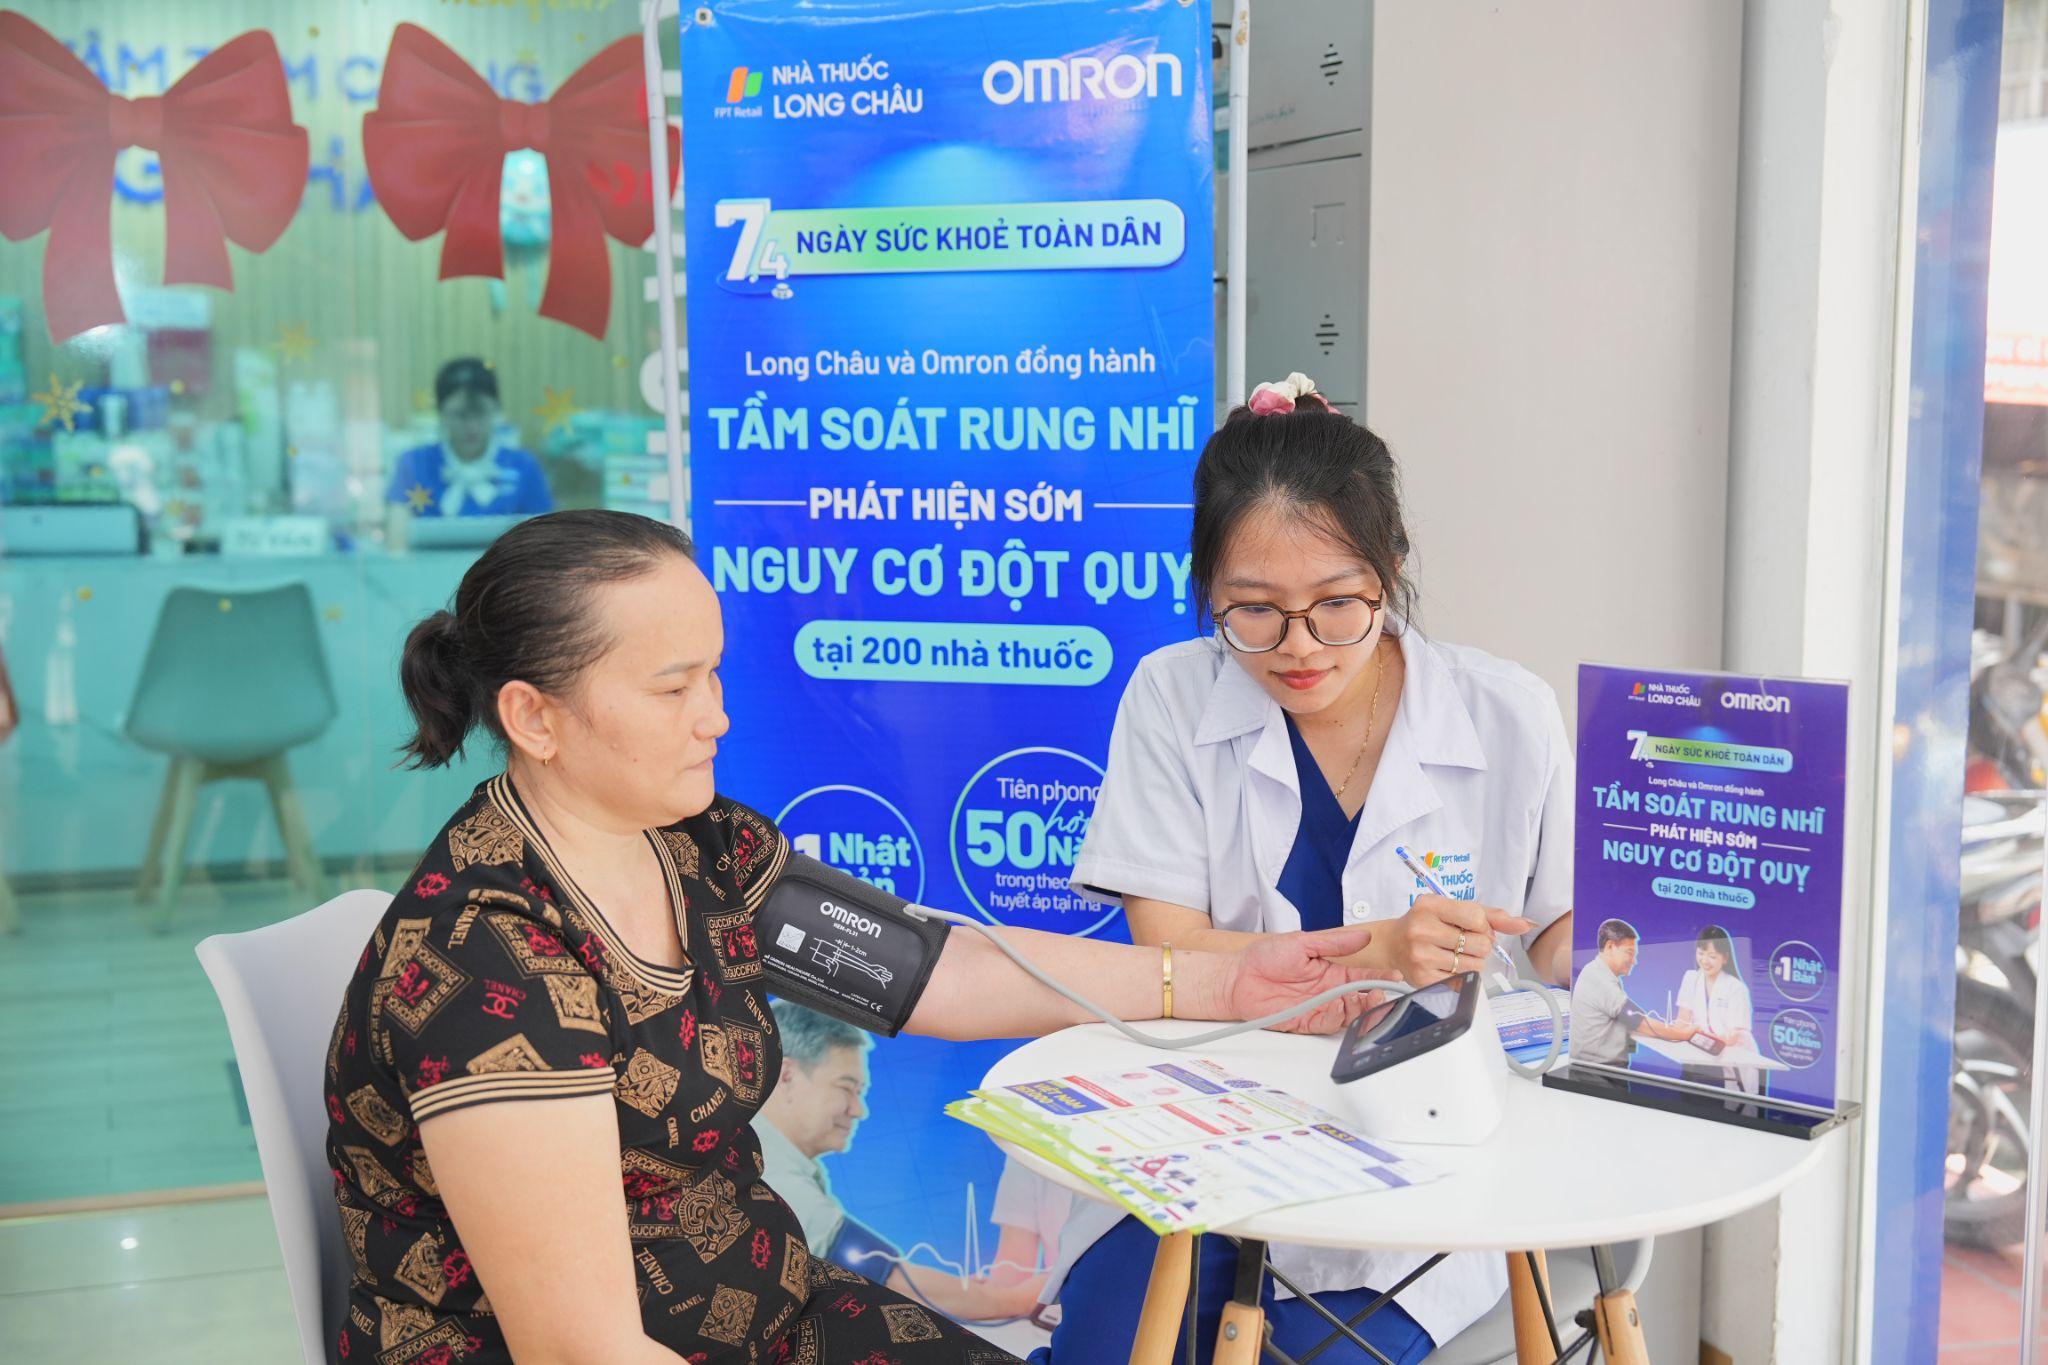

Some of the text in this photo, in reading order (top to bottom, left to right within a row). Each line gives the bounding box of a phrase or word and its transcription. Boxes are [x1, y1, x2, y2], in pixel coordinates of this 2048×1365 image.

[772, 53, 889, 85] NHÀ THUỐC
[714, 105, 762, 118] FPT Retail
[773, 83, 923, 119] LONG CHÂU
[797, 216, 1160, 253] NGÀY SỨC KHOẺ TOÀN DÂN
[745, 344, 1156, 382] Long Châu và Omron đồng hành
[708, 390, 1199, 451] TẦM SOÁT RUNG NHĨ
[809, 480, 1082, 530] PHÁT HIỆN SỚM
[712, 538, 1193, 615] NGUY CƠ ĐỘT QUỴ
[812, 635, 1093, 671] tại 200 nhà thuốc
[1648, 694, 1674, 705] LONG
[1675, 695, 1701, 708] CHÂU
[996, 777, 1038, 800] Tiên
[1648, 775, 1667, 788] Long
[1668, 778, 1686, 790] Châu
[1697, 781, 1723, 793] Omron
[1592, 781, 1826, 835] TẦM SOÁT RUNG NHĨ
[829, 832, 911, 875] Nhật
[966, 809, 1046, 870] 50
[1650, 823, 1757, 849] PHÁT HIỆN SỚM
[995, 871, 1035, 892] trong
[1602, 839, 1810, 893] NGUY CƠ ĐỘT QUỴ
[705, 876, 727, 901] CHANEL
[990, 891, 1031, 911] huyết
[1032, 893, 1051, 912] áp
[1052, 896, 1072, 913] tại
[1657, 882, 1671, 894] tại
[1674, 884, 1694, 896] 200
[1696, 887, 1715, 900] nhà
[1773, 1024, 1798, 1046] 50
[690, 1086, 727, 1123] CHANEL
[634, 1246, 674, 1295] CHANEL
[668, 1293, 705, 1316] CHANEL
[762, 1301, 795, 1341] CHANEL
